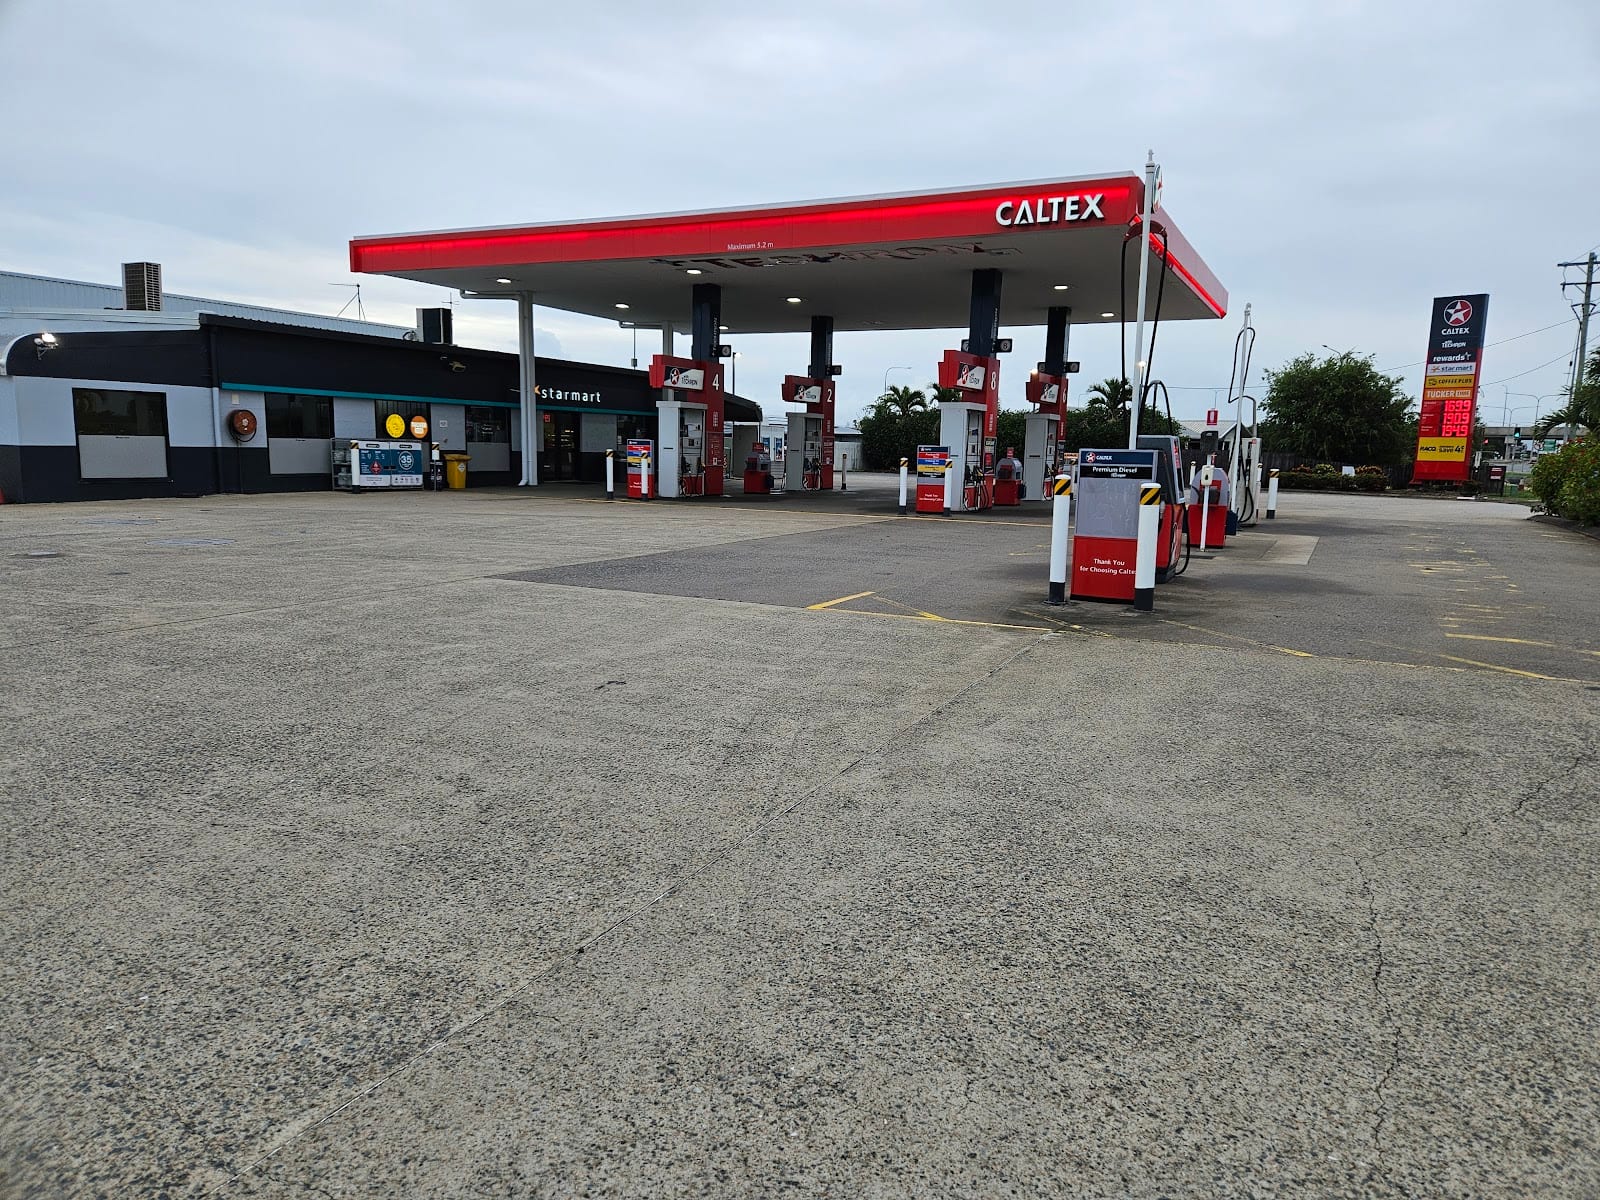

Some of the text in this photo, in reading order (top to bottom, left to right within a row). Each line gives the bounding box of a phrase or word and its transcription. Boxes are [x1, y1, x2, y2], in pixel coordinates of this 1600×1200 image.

[995, 193, 1105, 226] CALTEX
[1441, 327, 1470, 335] CALTEX
[1433, 354, 1466, 362] rewards
[712, 373, 720, 391] 4
[990, 371, 997, 391] 8
[541, 387, 601, 403] starmart
[827, 388, 833, 403] 2
[1062, 388, 1067, 404] 6
[400, 455, 412, 464] 35
[1089, 566, 1118, 576] Choosing
